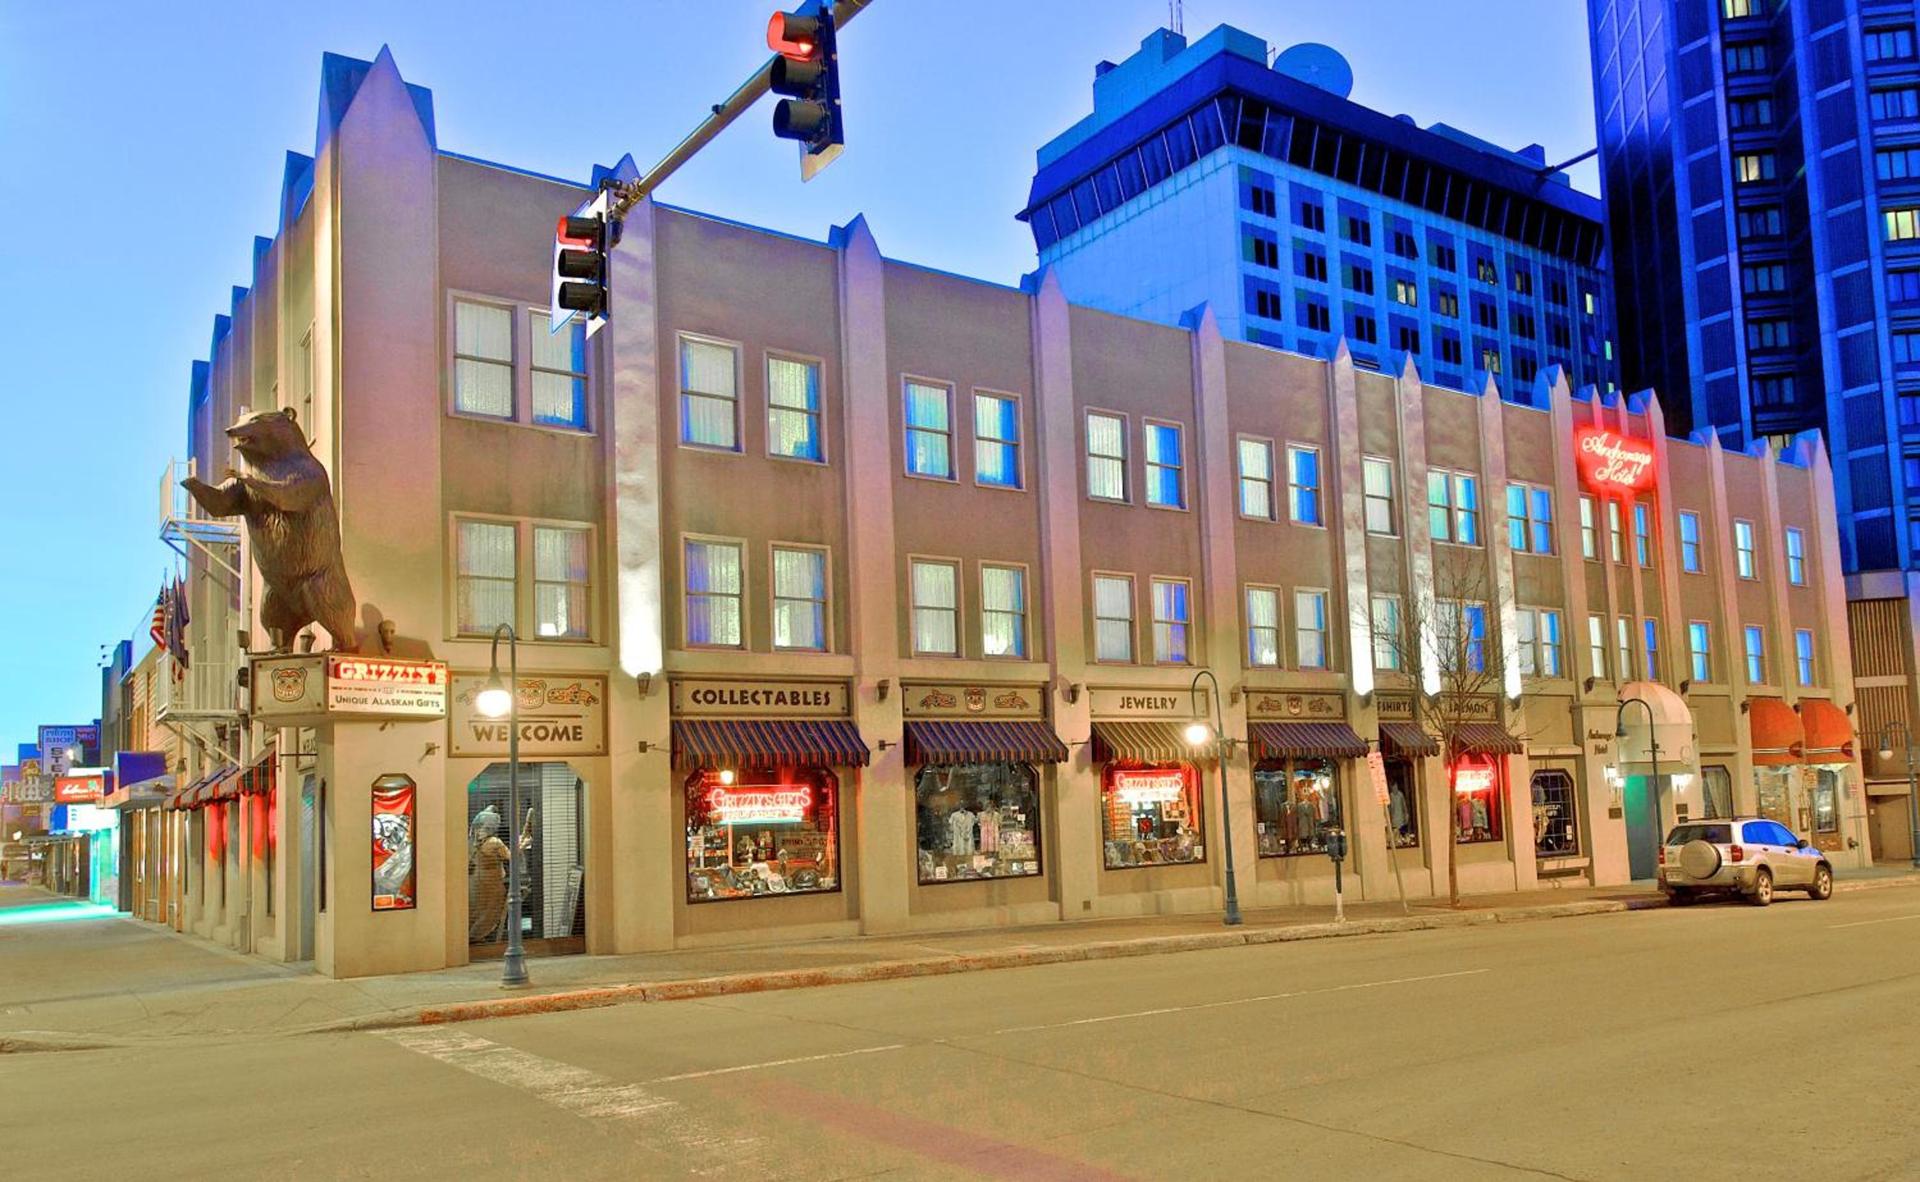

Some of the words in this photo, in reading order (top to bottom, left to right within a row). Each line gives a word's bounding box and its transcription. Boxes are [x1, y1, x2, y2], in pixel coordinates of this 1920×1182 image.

[1582, 432, 1651, 475] Anchorage
[1595, 459, 1638, 485] Hotel
[340, 662, 447, 684] GRIZZLY'S
[691, 689, 831, 706] COLLECTABLES
[1119, 697, 1177, 710] JEWELRY
[473, 725, 583, 742] WECOME
